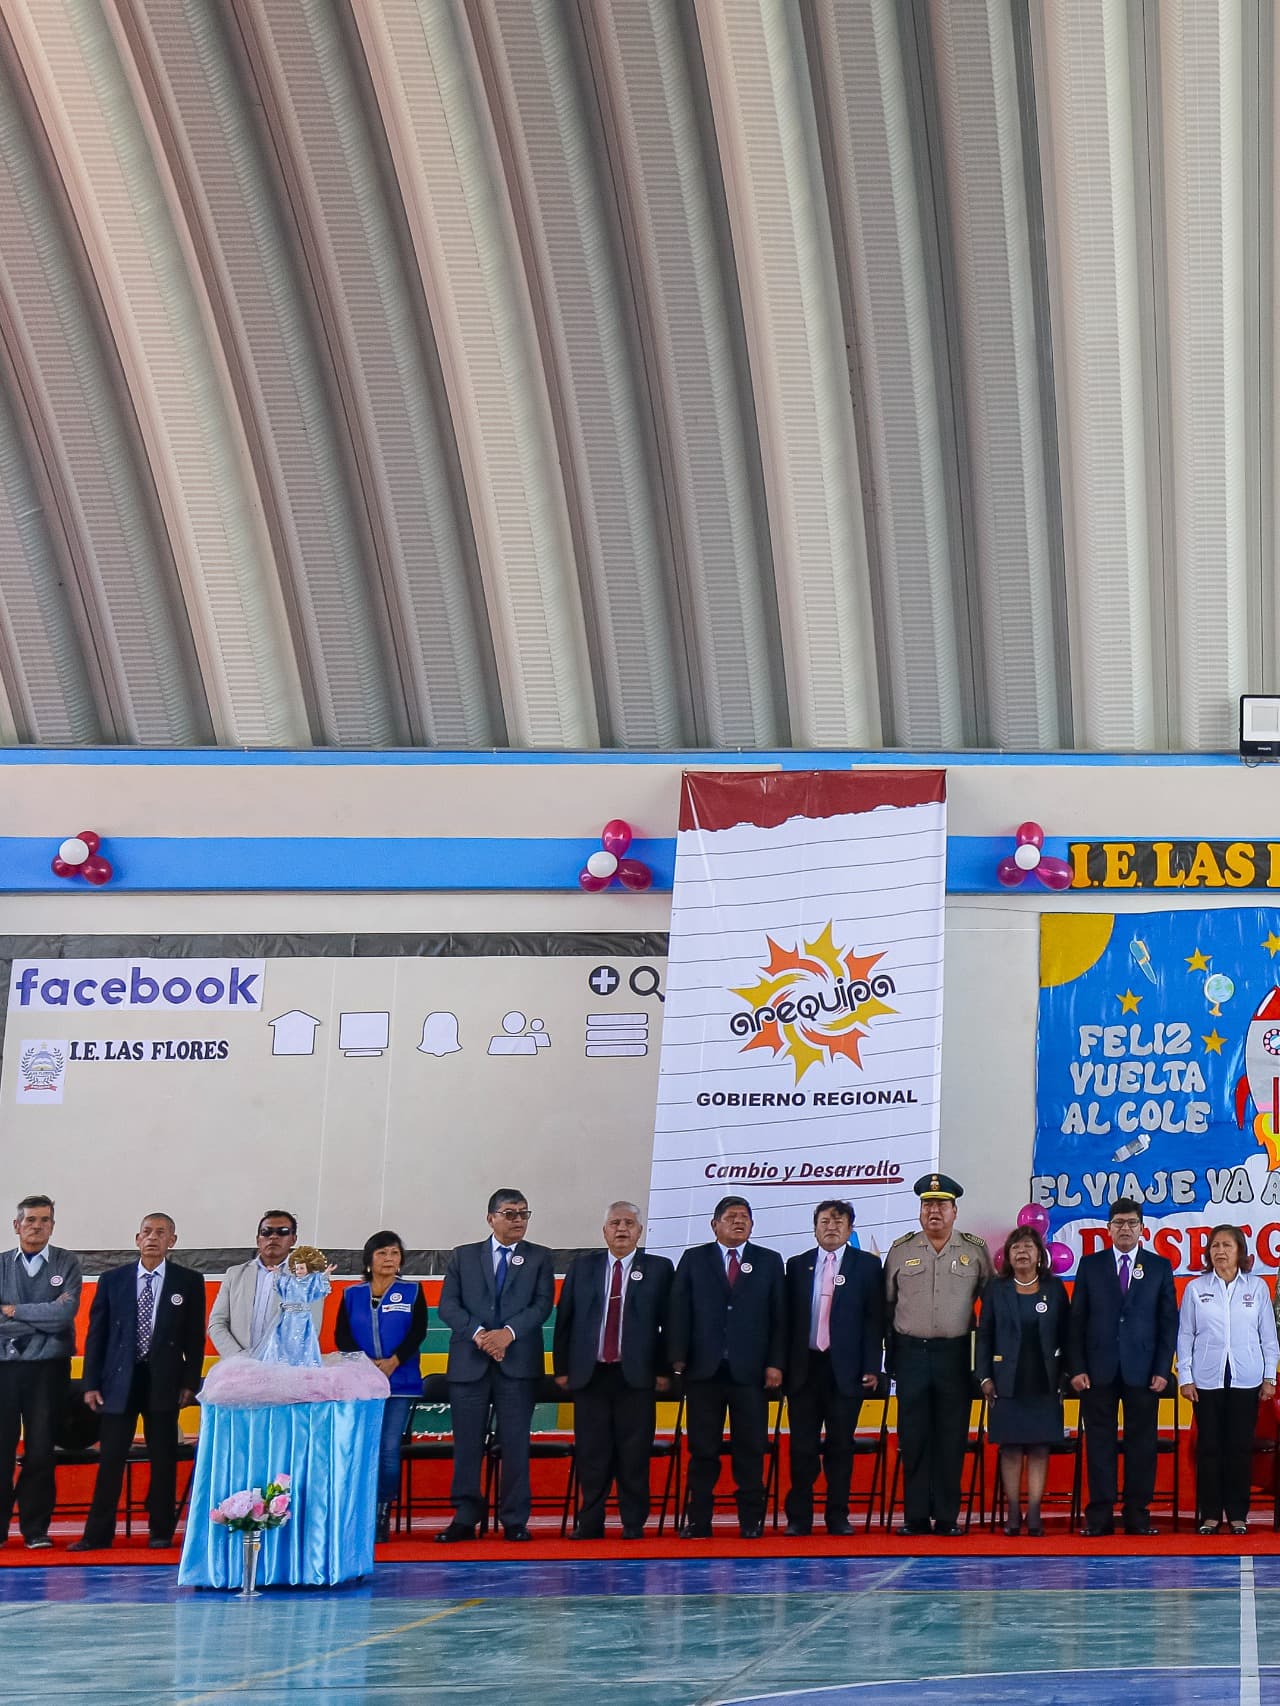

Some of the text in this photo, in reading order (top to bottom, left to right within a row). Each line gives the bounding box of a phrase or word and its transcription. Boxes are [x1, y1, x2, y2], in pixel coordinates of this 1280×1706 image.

[1070, 843, 1143, 887] I.E.
[1153, 843, 1256, 887] LAS
[16, 967, 259, 1006] facebook
[69, 1040, 229, 1061] I.E. LAS FLORES
[1079, 1022, 1192, 1057] FELIZ
[1069, 1060, 1207, 1097] VUELTA
[697, 1090, 918, 1107] GOBIERNO REGIONAL
[1060, 1099, 1211, 1135] AL COLE
[704, 1159, 901, 1181] Cambio y Desarrollo
[1030, 1173, 1081, 1209] EL
[1083, 1169, 1196, 1206] VIAJE
[1206, 1168, 1254, 1204] VA
